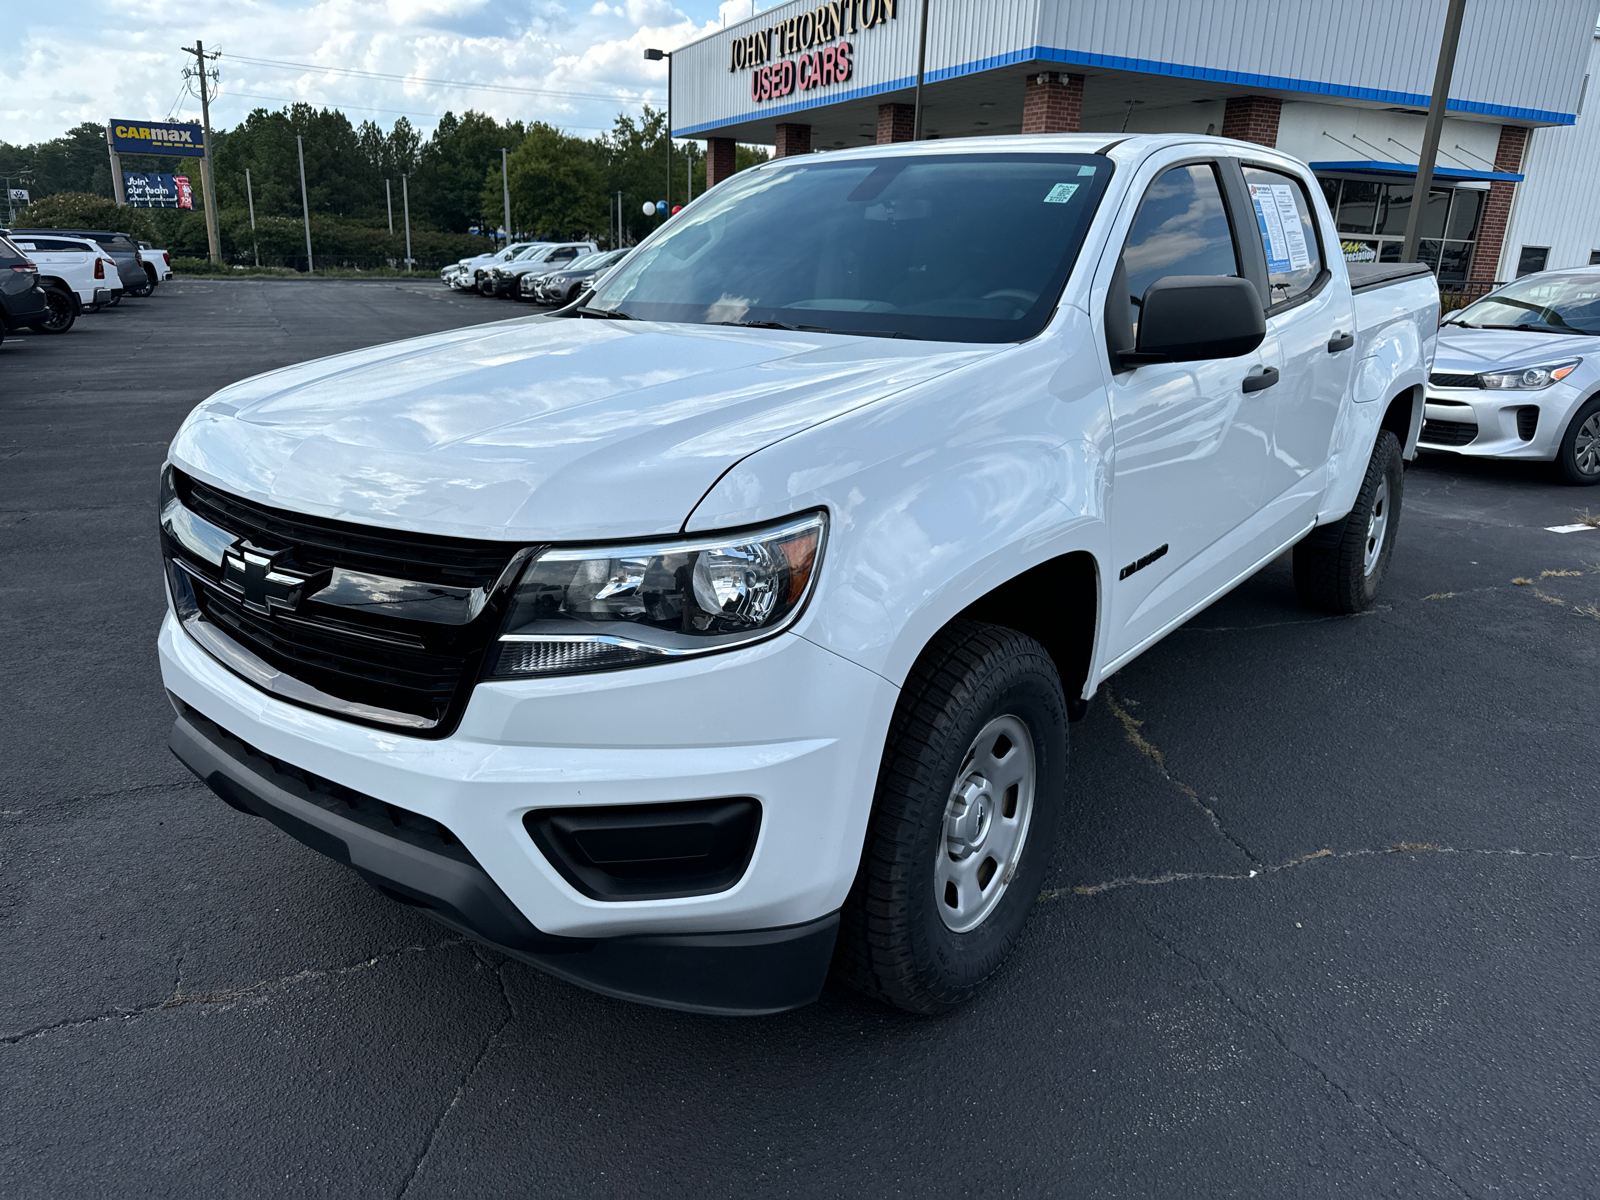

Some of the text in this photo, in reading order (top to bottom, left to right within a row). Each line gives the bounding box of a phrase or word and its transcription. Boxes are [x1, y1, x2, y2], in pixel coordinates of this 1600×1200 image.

[728, 0, 896, 73] JOHN THORNTON
[751, 41, 852, 102] USED CARS
[127, 176, 146, 186] Join
[127, 185, 169, 195] our team
